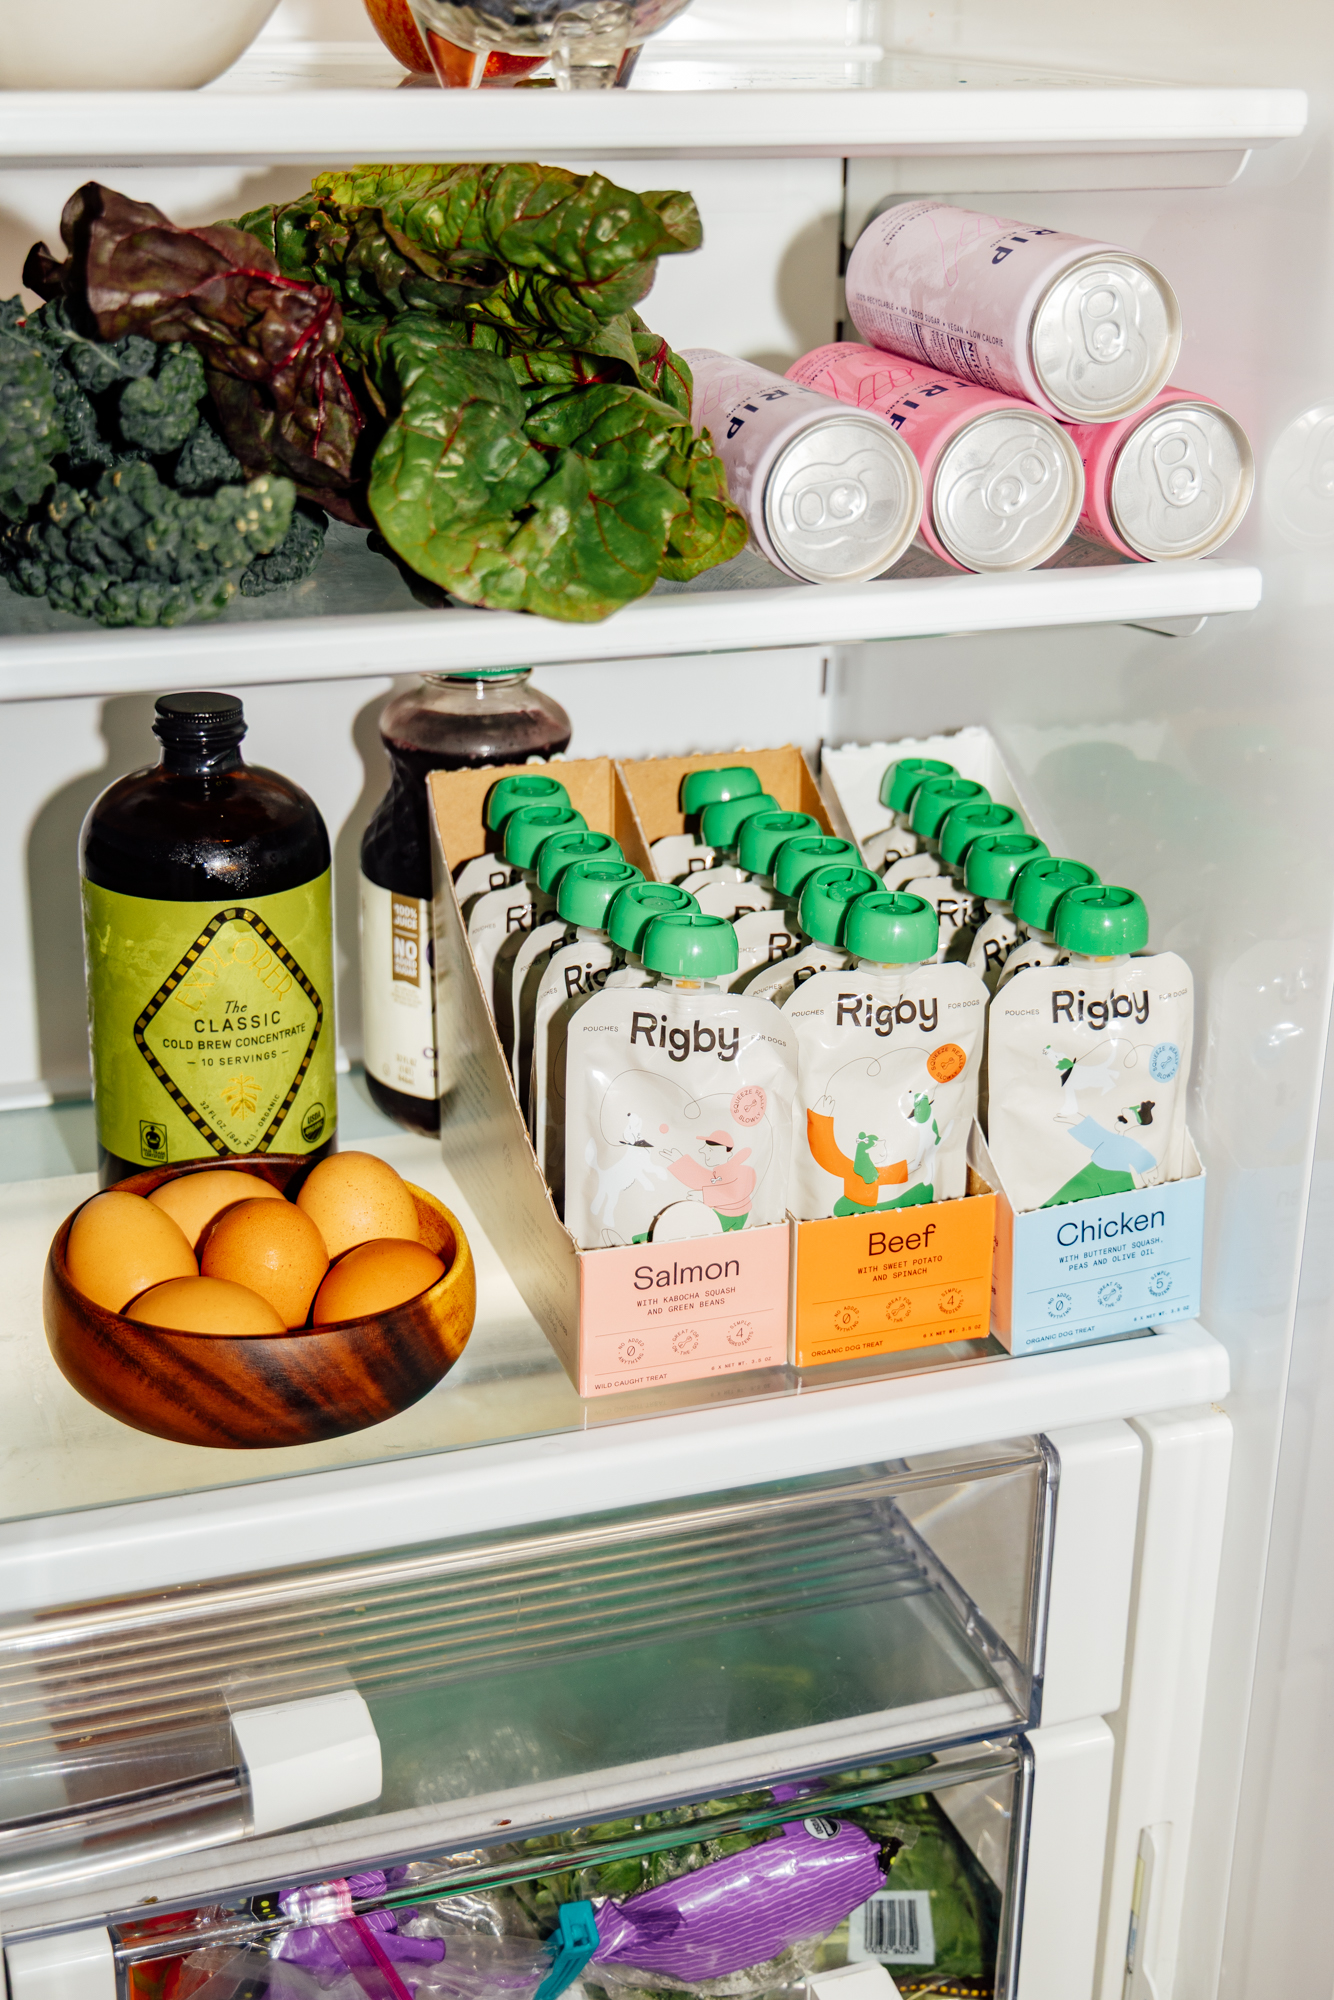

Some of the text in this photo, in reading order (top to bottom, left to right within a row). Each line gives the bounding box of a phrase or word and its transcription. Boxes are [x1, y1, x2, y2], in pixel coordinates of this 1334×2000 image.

[991, 229, 1059, 265] RIP
[867, 295, 894, 310] RECYCLABLE
[901, 306, 907, 315] NO
[909, 309, 924, 320] ADDED
[925, 314, 940, 324] SUGAR
[947, 322, 964, 334] VEGAN
[970, 329, 981, 340] LOW
[982, 333, 1004, 347] CALORIE
[726, 396, 751, 418] BLEND
[885, 392, 909, 415] BLEND
[393, 903, 417, 919] 100%
[393, 915, 418, 930] JUICE
[394, 936, 418, 960] NO
[174, 938, 293, 1012] EXPLORER
[394, 965, 418, 978] SUGAR
[753, 984, 783, 996] POUCHES
[225, 1001, 248, 1014] The
[791, 1009, 825, 1017] POUCHES
[836, 993, 938, 1037] Rigby
[962, 999, 980, 1008] DOGS
[1051, 988, 1150, 1031] Rigby
[195, 1010, 281, 1033] CLASSIC
[163, 1023, 306, 1051] COLD BREW CONCENTRATE
[630, 1011, 739, 1062] Rigby
[750, 1034, 766, 1042] FOR
[767, 1036, 787, 1047] DOGS
[201, 1050, 277, 1067] 10 SERVINGS
[930, 1046, 949, 1071] SQUEEZE
[951, 1047, 964, 1069] REALLY
[1152, 1045, 1166, 1072] SQUEEZE
[1156, 1067, 1175, 1080] SLOWLY
[733, 1089, 753, 1114] SQUEEZE
[200, 1101, 210, 1110] 32
[208, 1110, 217, 1120] FL
[257, 1094, 280, 1127] ORGANIC
[738, 1111, 761, 1124] SLOWLY
[1057, 1210, 1165, 1246] Chicken
[868, 1223, 936, 1257] Beef
[1059, 1255, 1079, 1264] WITH
[1083, 1244, 1127, 1259] BUTTERNUT
[1068, 1248, 1154, 1271] PEAS AND OLIVE OIL
[857, 1255, 943, 1275] WITH SWEET POTATO
[633, 1259, 740, 1290] Salmon
[872, 1267, 928, 1282] AND SPINACH
[1150, 1270, 1171, 1281] SIMPLE
[1156, 1277, 1164, 1289] 5
[637, 1286, 736, 1307] WITH KABOCHA SQUASH
[941, 1287, 962, 1297] SIMPLE
[1097, 1281, 1123, 1295] GREAT FOR
[647, 1298, 725, 1316] AND GREEN BEANS
[886, 1296, 912, 1310] GREAT FOR
[937, 1299, 964, 1315] INGREDIENTS
[947, 1295, 954, 1306] 4
[1047, 1292, 1072, 1305] NO ADDED
[834, 1305, 860, 1318] NO ADDED
[1047, 1307, 1072, 1319] ANYTHING
[729, 1320, 751, 1330] SIMPLE
[736, 1327, 743, 1338] 4
[834, 1320, 859, 1332] ANYTHING
[671, 1328, 700, 1342] GREAT FOR
[726, 1330, 754, 1347] INGREDIENTS
[1025, 1325, 1096, 1345] ORGANIC DOG TREAT
[618, 1338, 645, 1350] NO ADDED
[811, 1340, 883, 1357] ORGANIC DOG TREAT
[618, 1352, 644, 1365] ANYTHING
[594, 1373, 668, 1390] WILD CAUGHT TREAT
